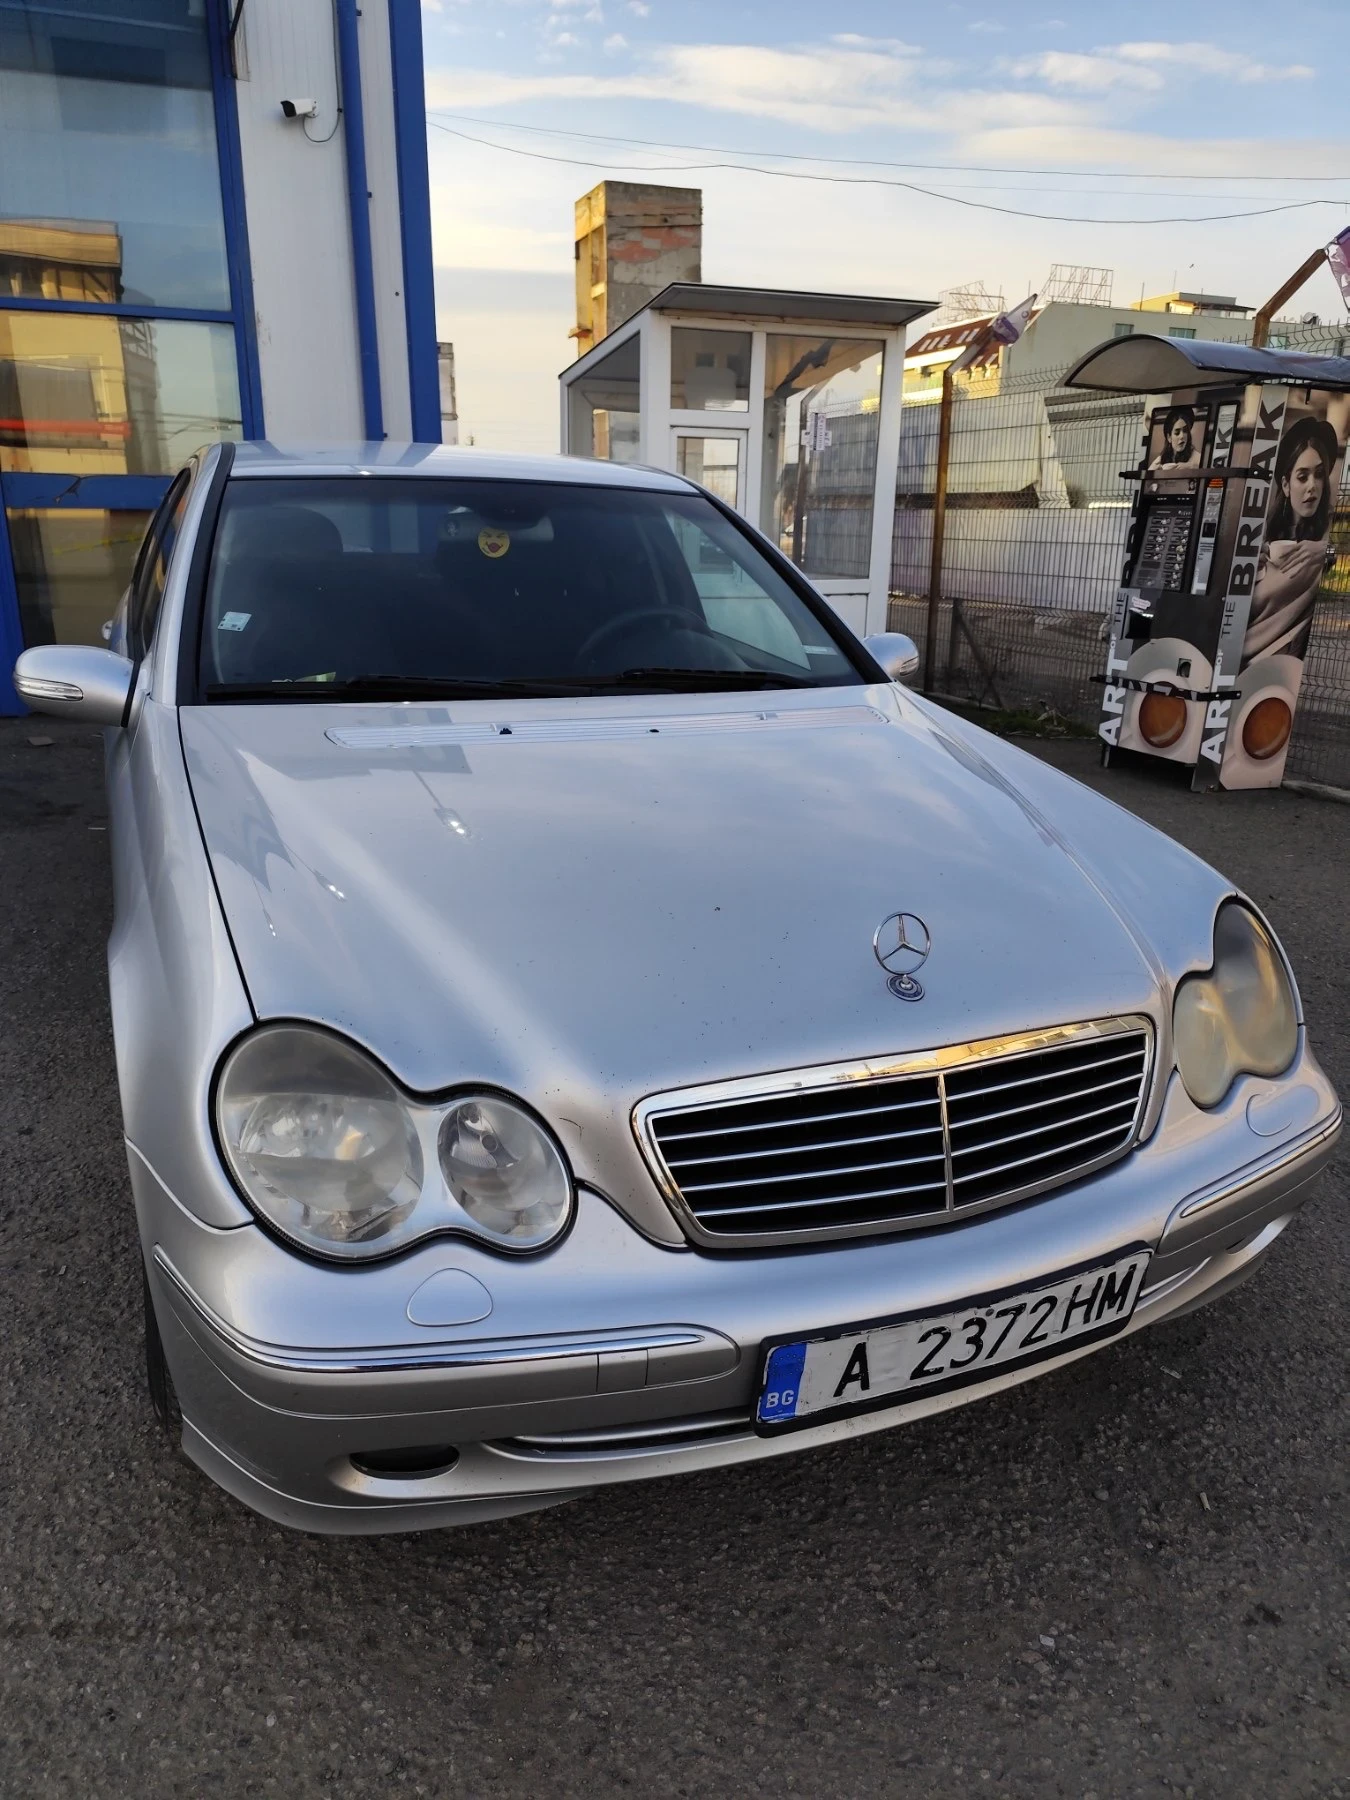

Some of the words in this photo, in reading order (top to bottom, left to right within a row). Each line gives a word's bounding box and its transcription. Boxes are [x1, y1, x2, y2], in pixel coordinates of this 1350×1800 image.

[1228, 400, 1286, 596] BREAK
[1221, 601, 1237, 638] THE
[1098, 648, 1129, 746] ART
[1114, 592, 1127, 625] THE
[1200, 666, 1237, 765] ART
[765, 1389, 795, 1409] BG
[833, 1341, 870, 1398] A
